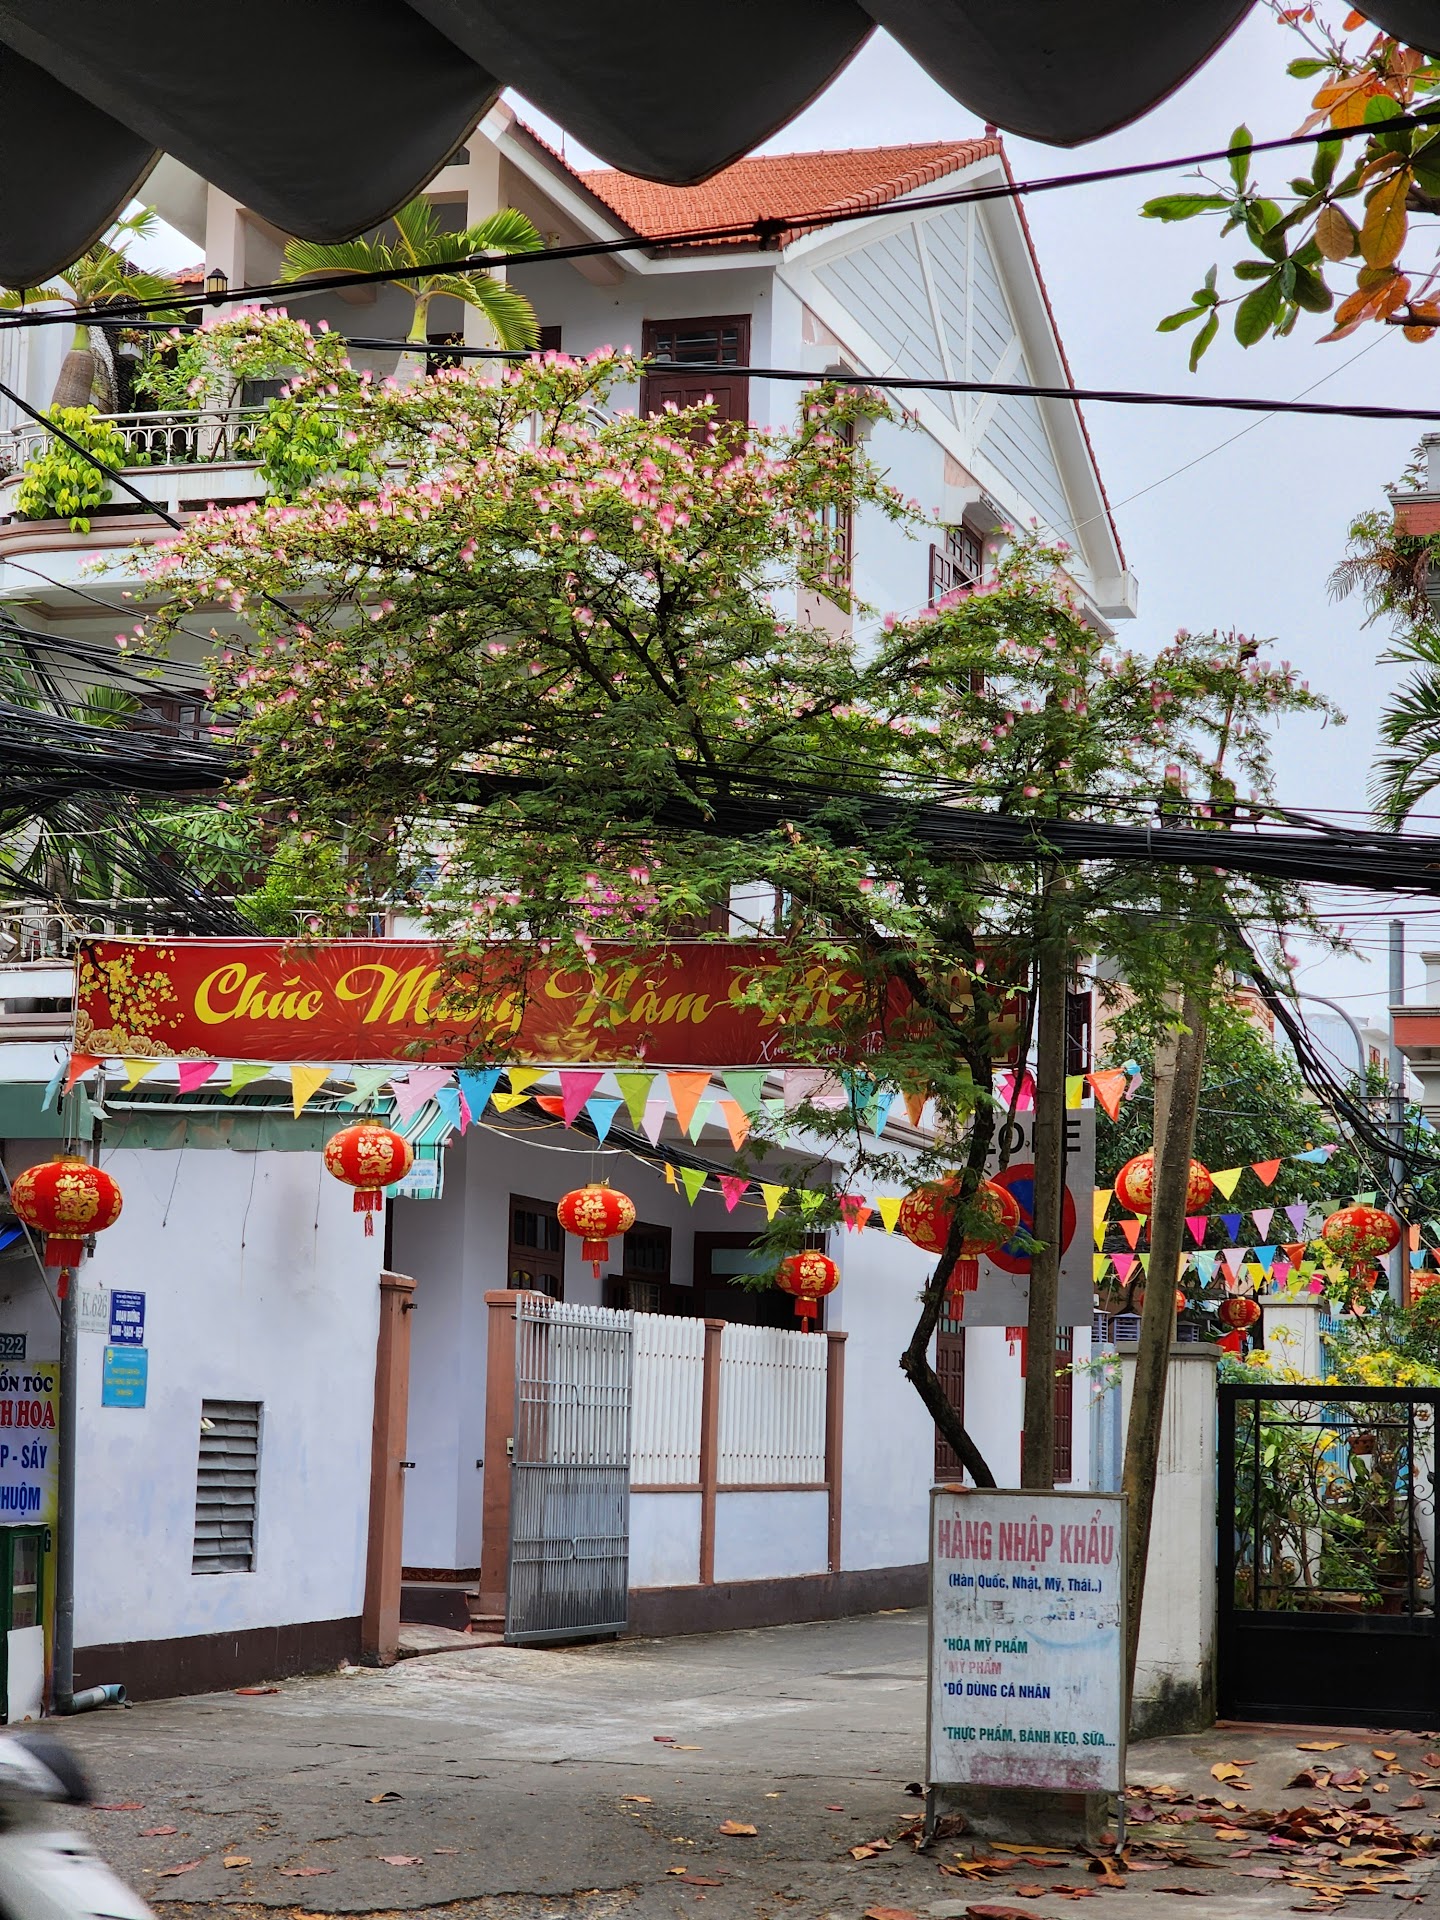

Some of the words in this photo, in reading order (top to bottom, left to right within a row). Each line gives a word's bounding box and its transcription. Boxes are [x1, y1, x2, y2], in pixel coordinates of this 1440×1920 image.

[194, 961, 324, 1026] Chúc
[23, 1371, 53, 1393] TÓC
[16, 1400, 55, 1428] HOA
[21, 1437, 47, 1469] SẤY
[0, 1481, 41, 1516] HUỘM
[938, 1511, 993, 1560] HÀNG
[999, 1515, 1054, 1571] NHẬP
[1060, 1509, 1114, 1565] KHẨU
[949, 1573, 974, 1588] (Hàn
[978, 1573, 1009, 1590] Quốc,
[1012, 1576, 1042, 1593] Nhật,
[1045, 1576, 1065, 1593] Mỹ,
[974, 1637, 992, 1652] MỸ
[995, 1635, 1028, 1654] PHẨM
[968, 1657, 1002, 1675] PHẨM
[966, 1680, 997, 1697] DÙNG
[1000, 1682, 1016, 1698] CÁ
[1019, 1683, 1051, 1699] NHÂN
[948, 1726, 976, 1743] THỰC
[980, 1723, 1017, 1743] PHẨM,
[1019, 1727, 1051, 1743] BÁNH
[1054, 1731, 1079, 1747] KẸO,
